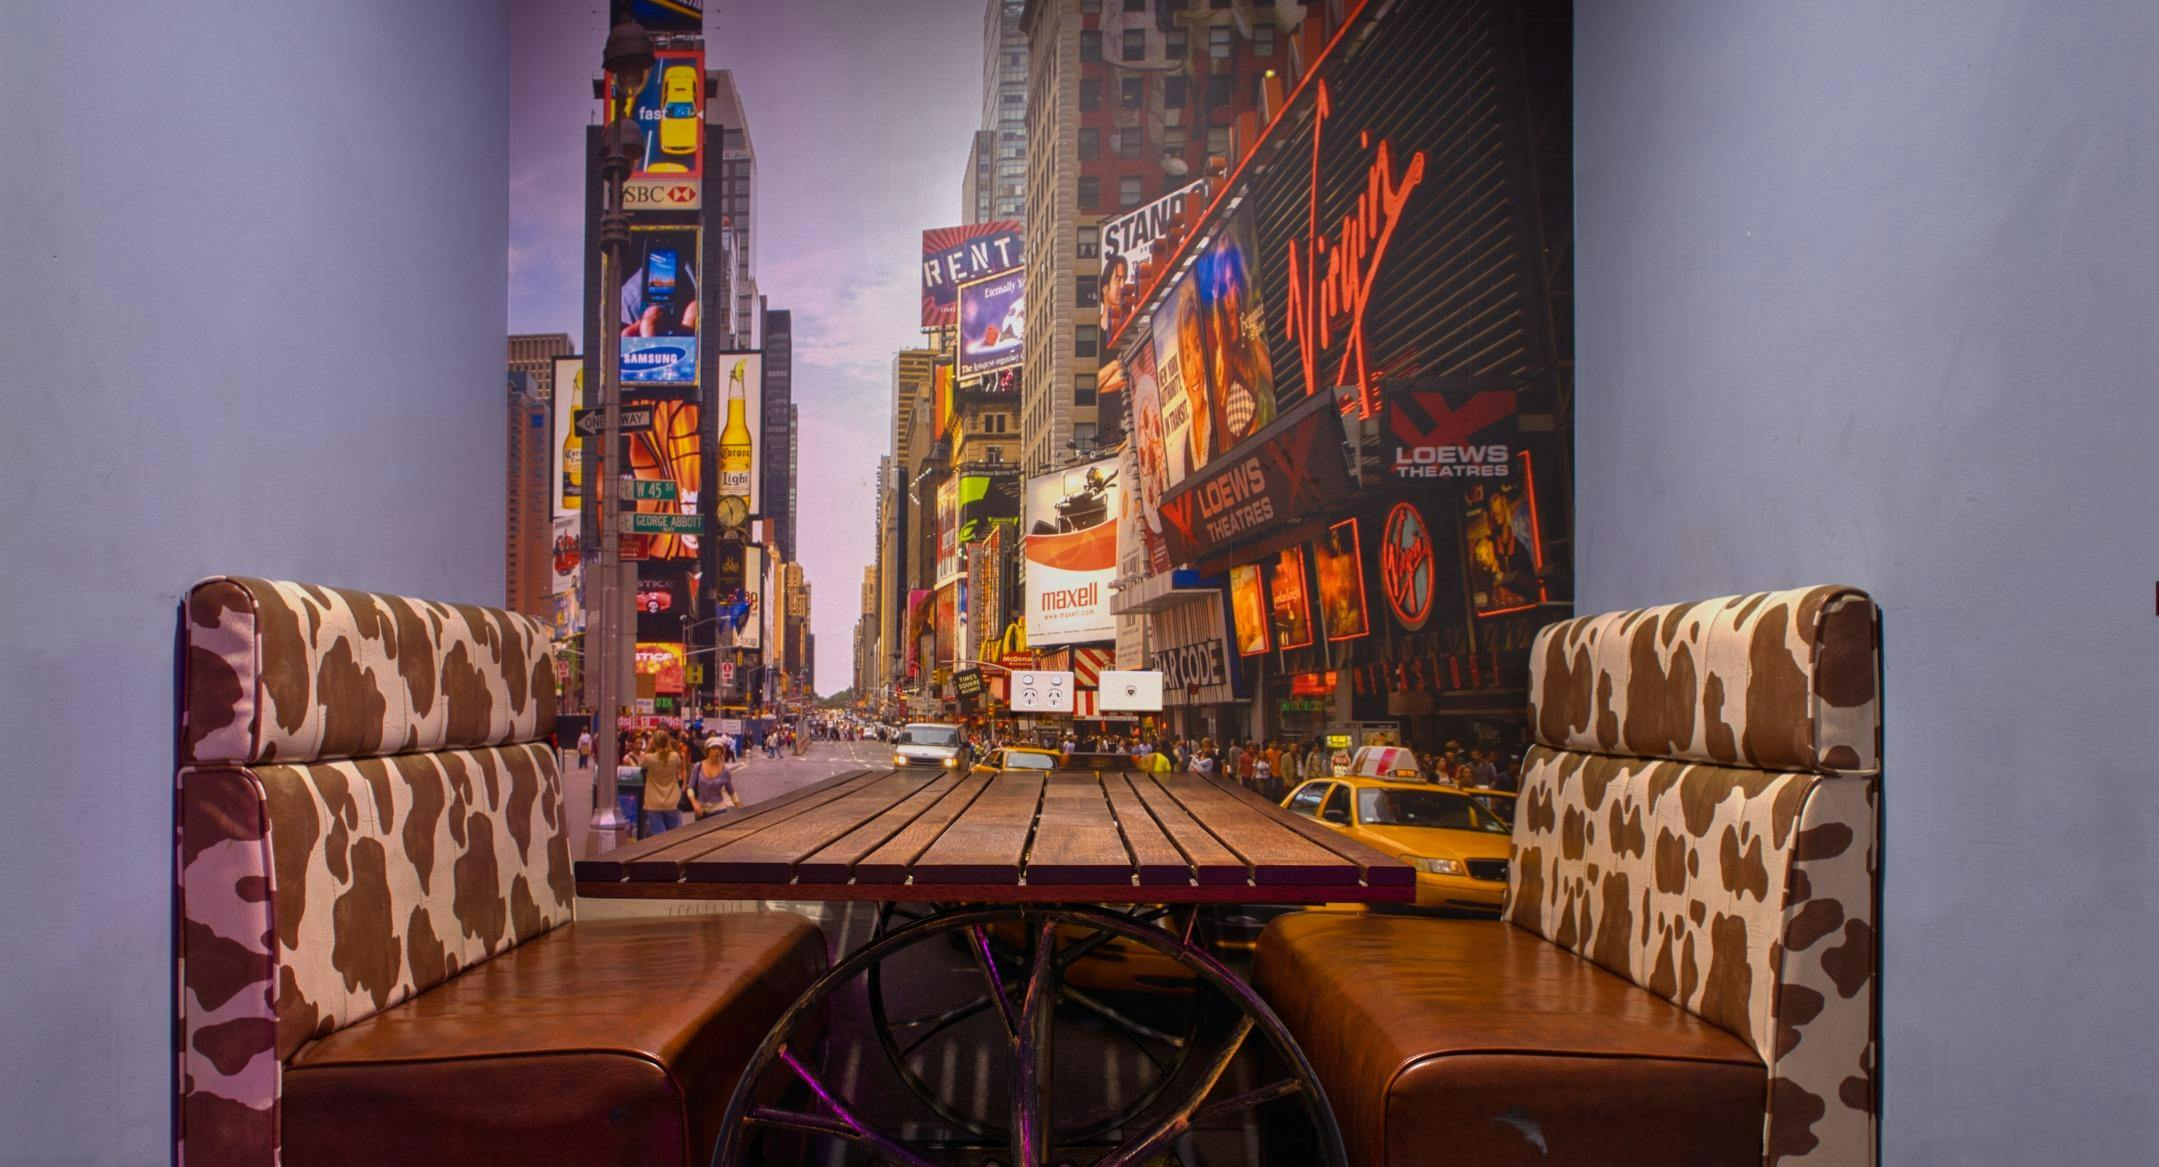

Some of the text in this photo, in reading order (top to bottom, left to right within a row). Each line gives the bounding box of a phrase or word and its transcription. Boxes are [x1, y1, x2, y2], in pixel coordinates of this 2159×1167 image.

[639, 106, 668, 120] fast
[623, 186, 665, 203] SBC
[1287, 76, 1425, 421] Virgin
[923, 237, 1011, 287] RENT
[984, 281, 1016, 298] Eternally
[623, 353, 678, 365] SAMSUNG
[620, 412, 644, 426] WAY
[1396, 445, 1509, 464] LOEWS
[1396, 465, 1509, 477] THEATRES
[637, 483, 646, 498] W
[648, 482, 662, 498] 45
[1197, 457, 1265, 518] LOEWS
[636, 515, 702, 528] GEORGE ABBOTT
[1206, 496, 1274, 543] THEATRES
[1042, 581, 1098, 611] maxell
[1180, 640, 1222, 688] CODE
